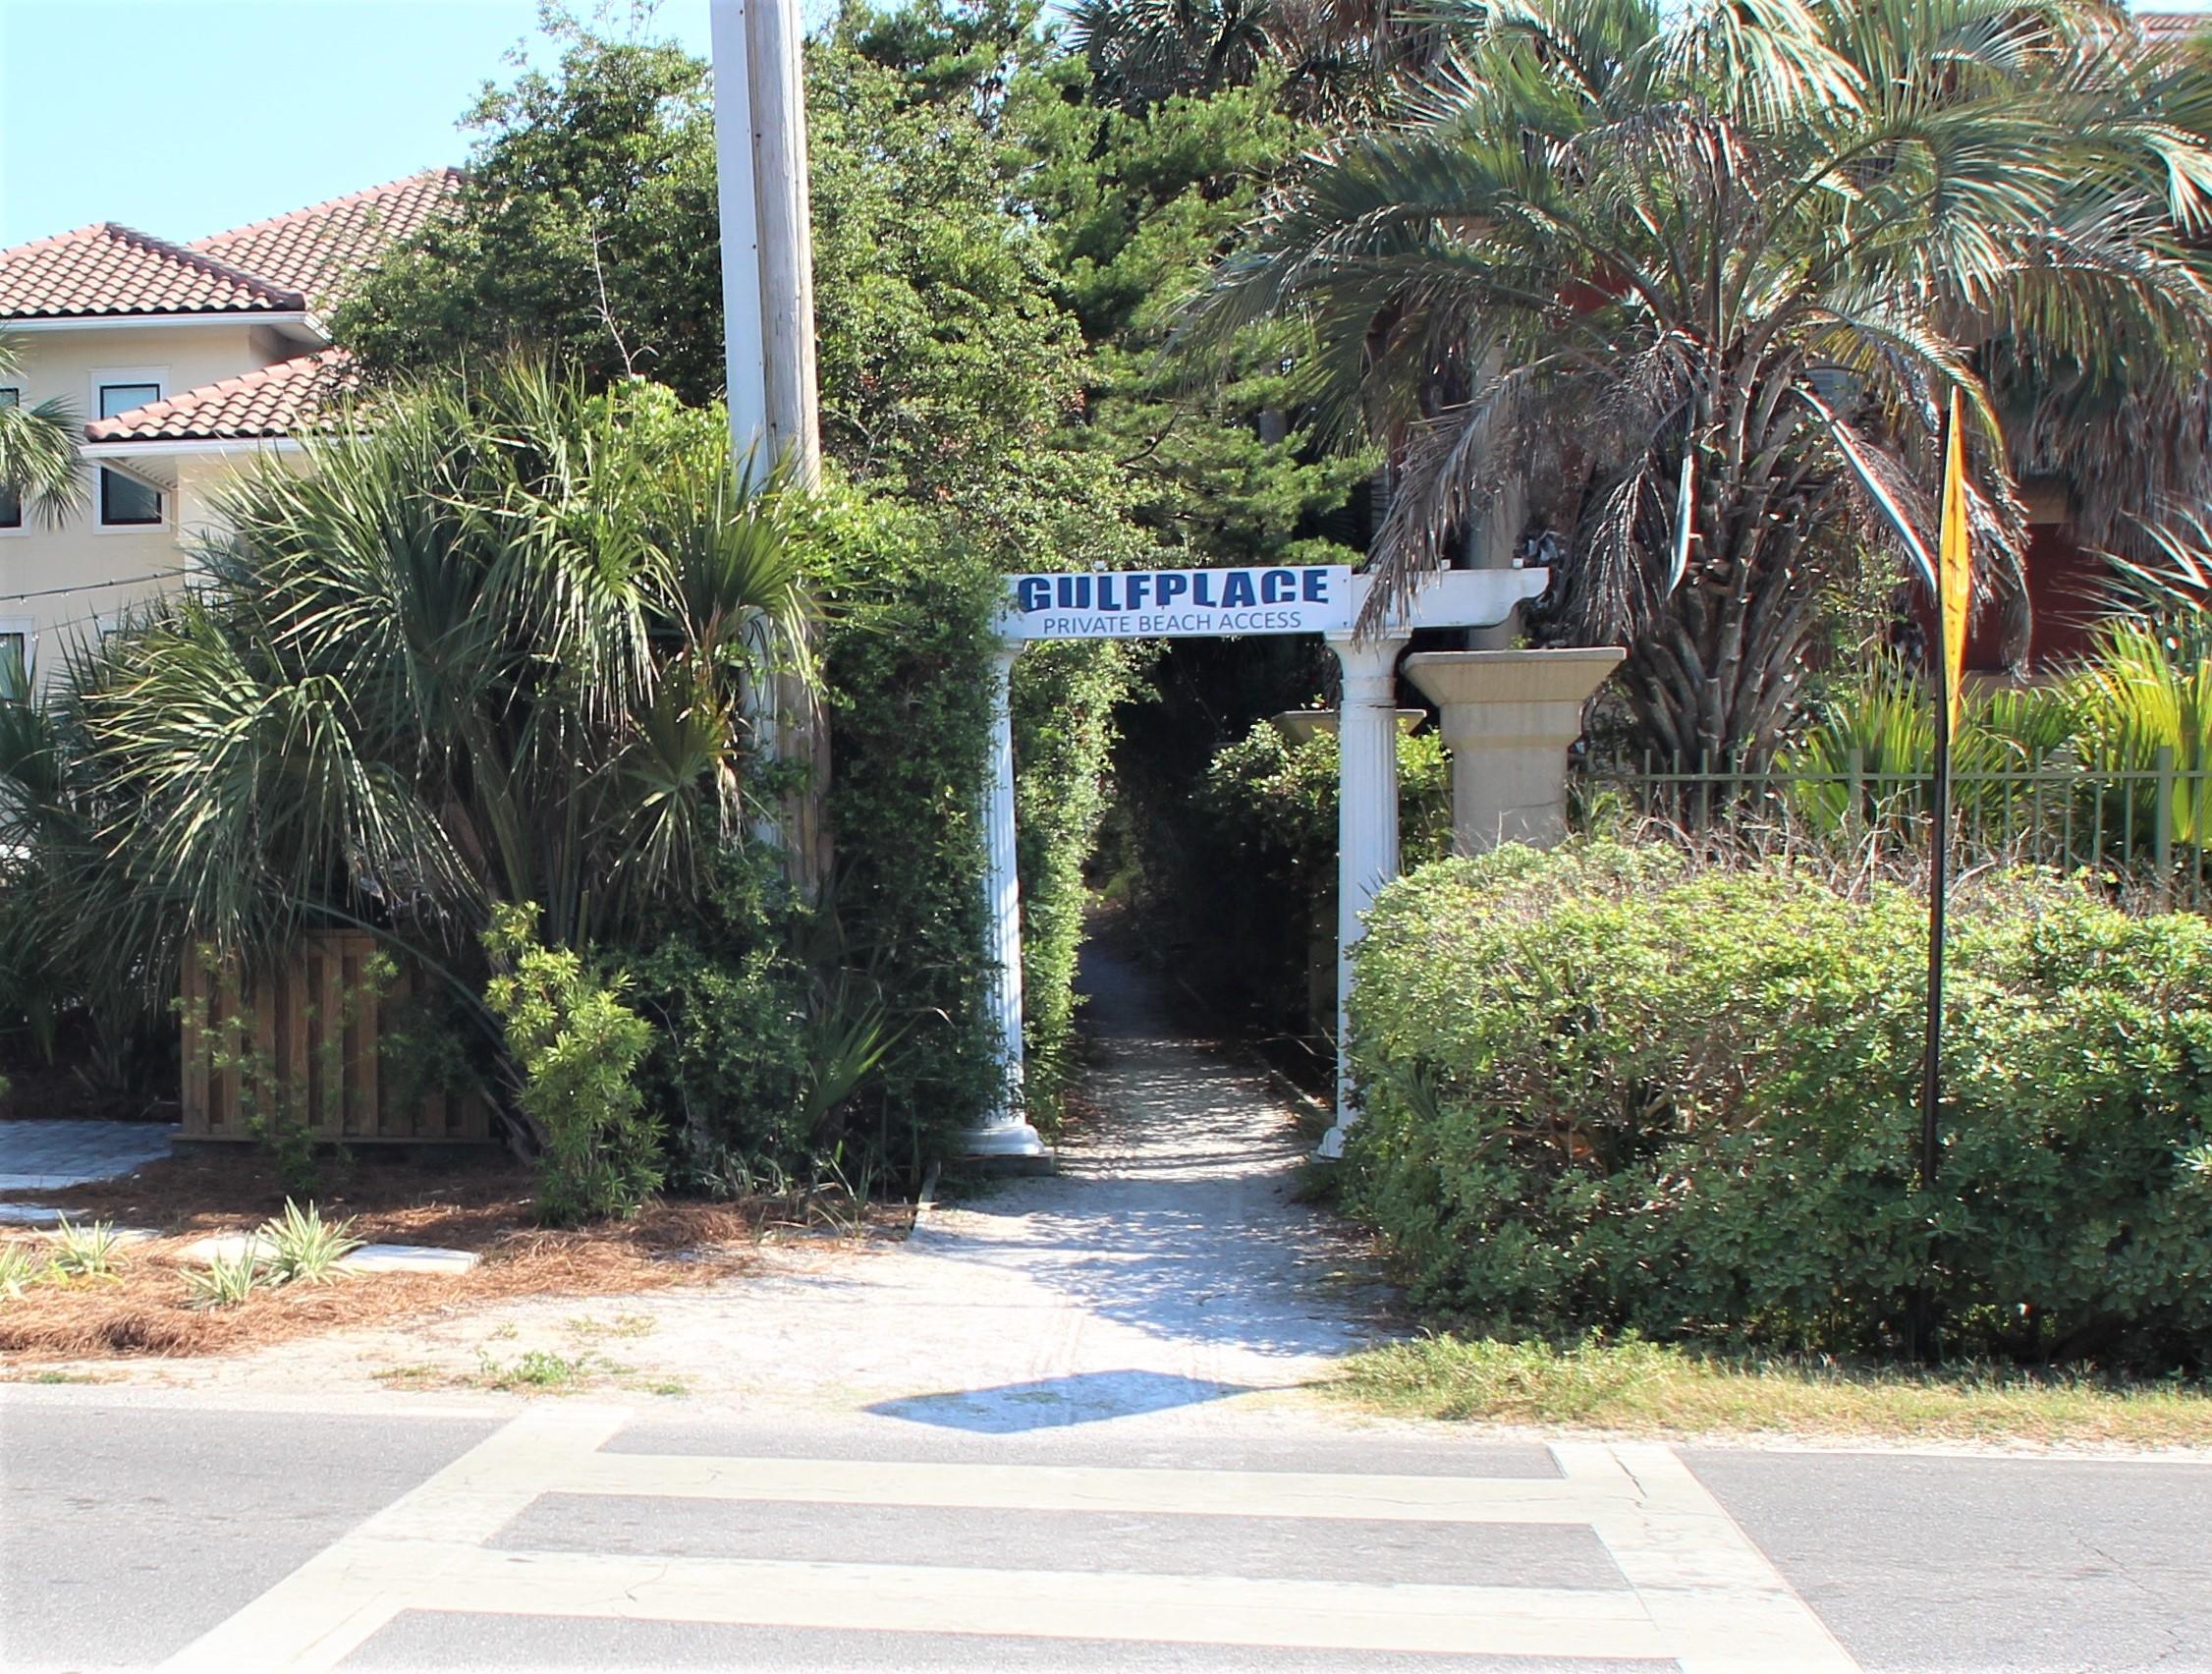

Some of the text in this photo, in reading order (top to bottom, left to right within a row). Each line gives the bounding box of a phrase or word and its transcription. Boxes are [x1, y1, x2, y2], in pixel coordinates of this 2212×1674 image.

[1018, 569, 1329, 613] GULFPLACE
[1043, 611, 1302, 634] PRIVATE BEACH ACCESS
